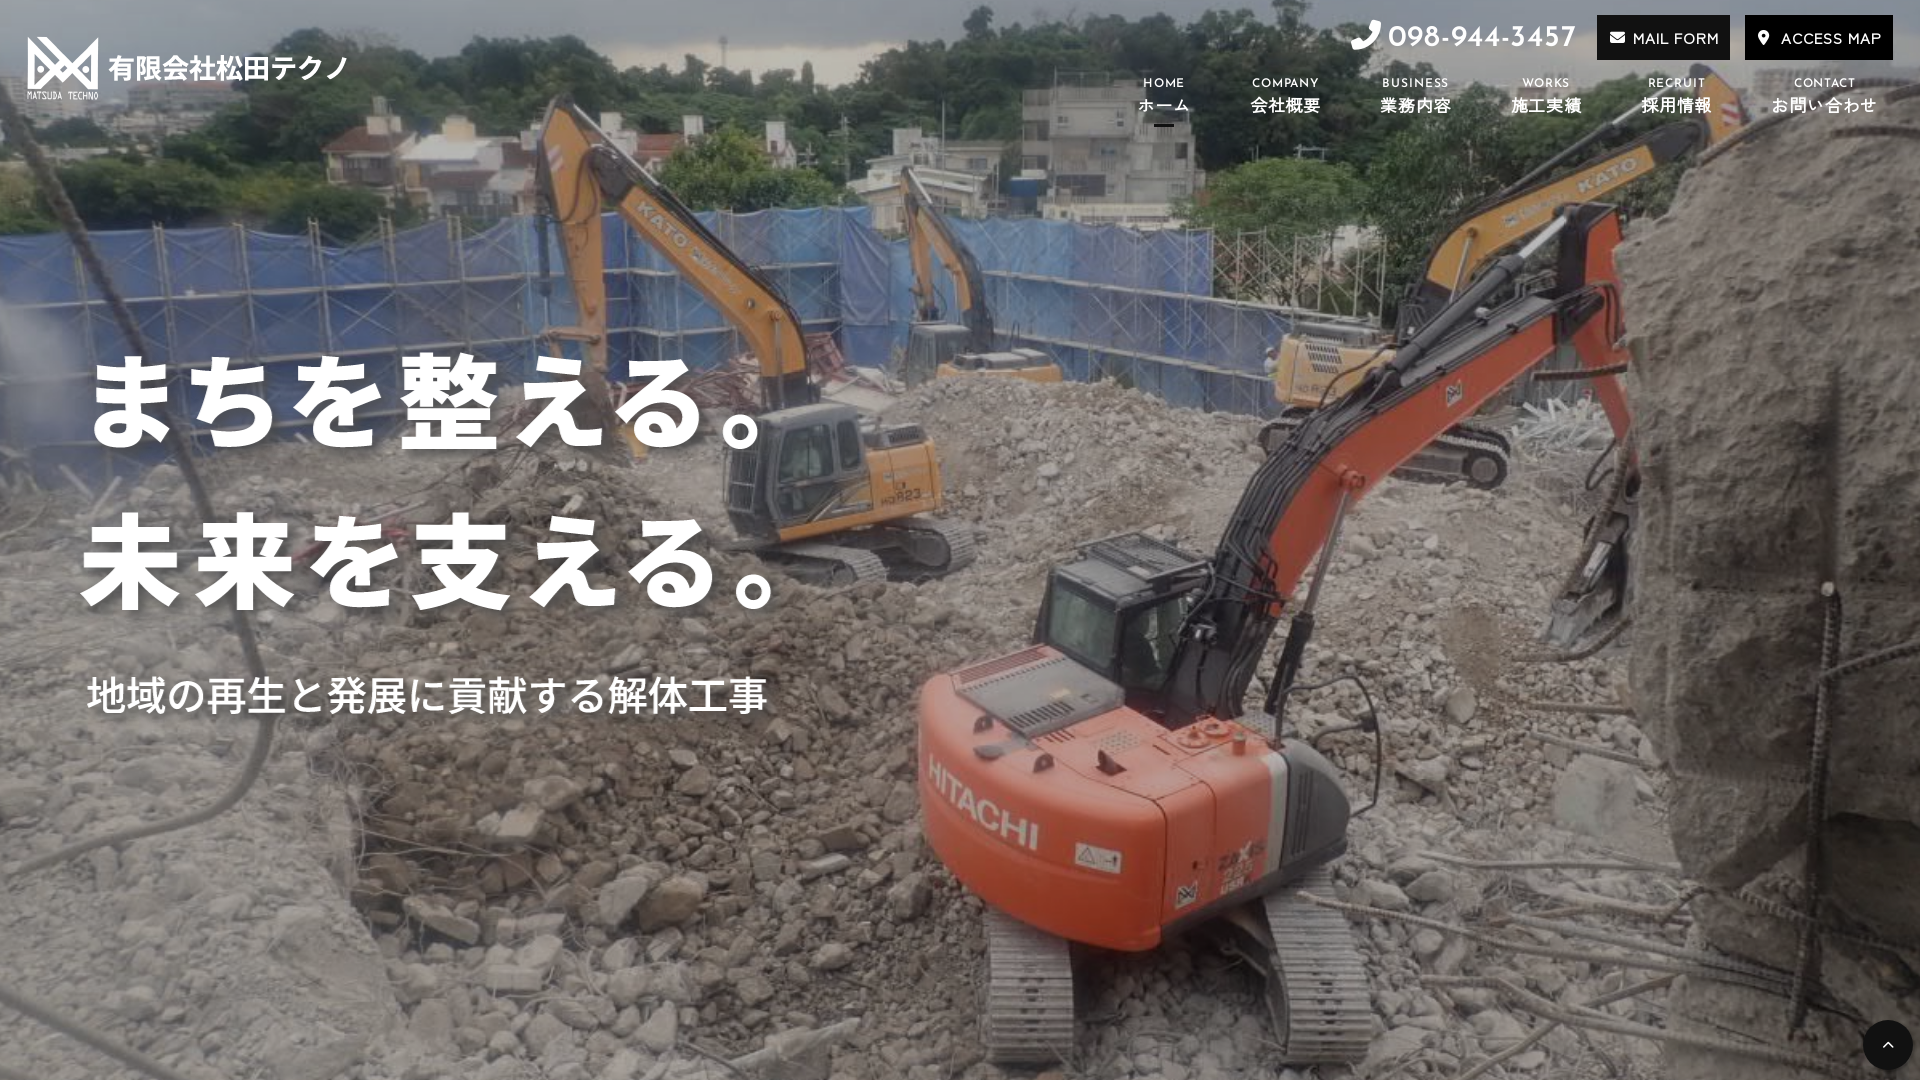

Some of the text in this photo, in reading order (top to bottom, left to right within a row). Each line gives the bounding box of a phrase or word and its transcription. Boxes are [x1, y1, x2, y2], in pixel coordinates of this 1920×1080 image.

[1577, 158, 1638, 194] KATO
[637, 201, 689, 248] KATO
[928, 753, 1039, 851] HITACHI
